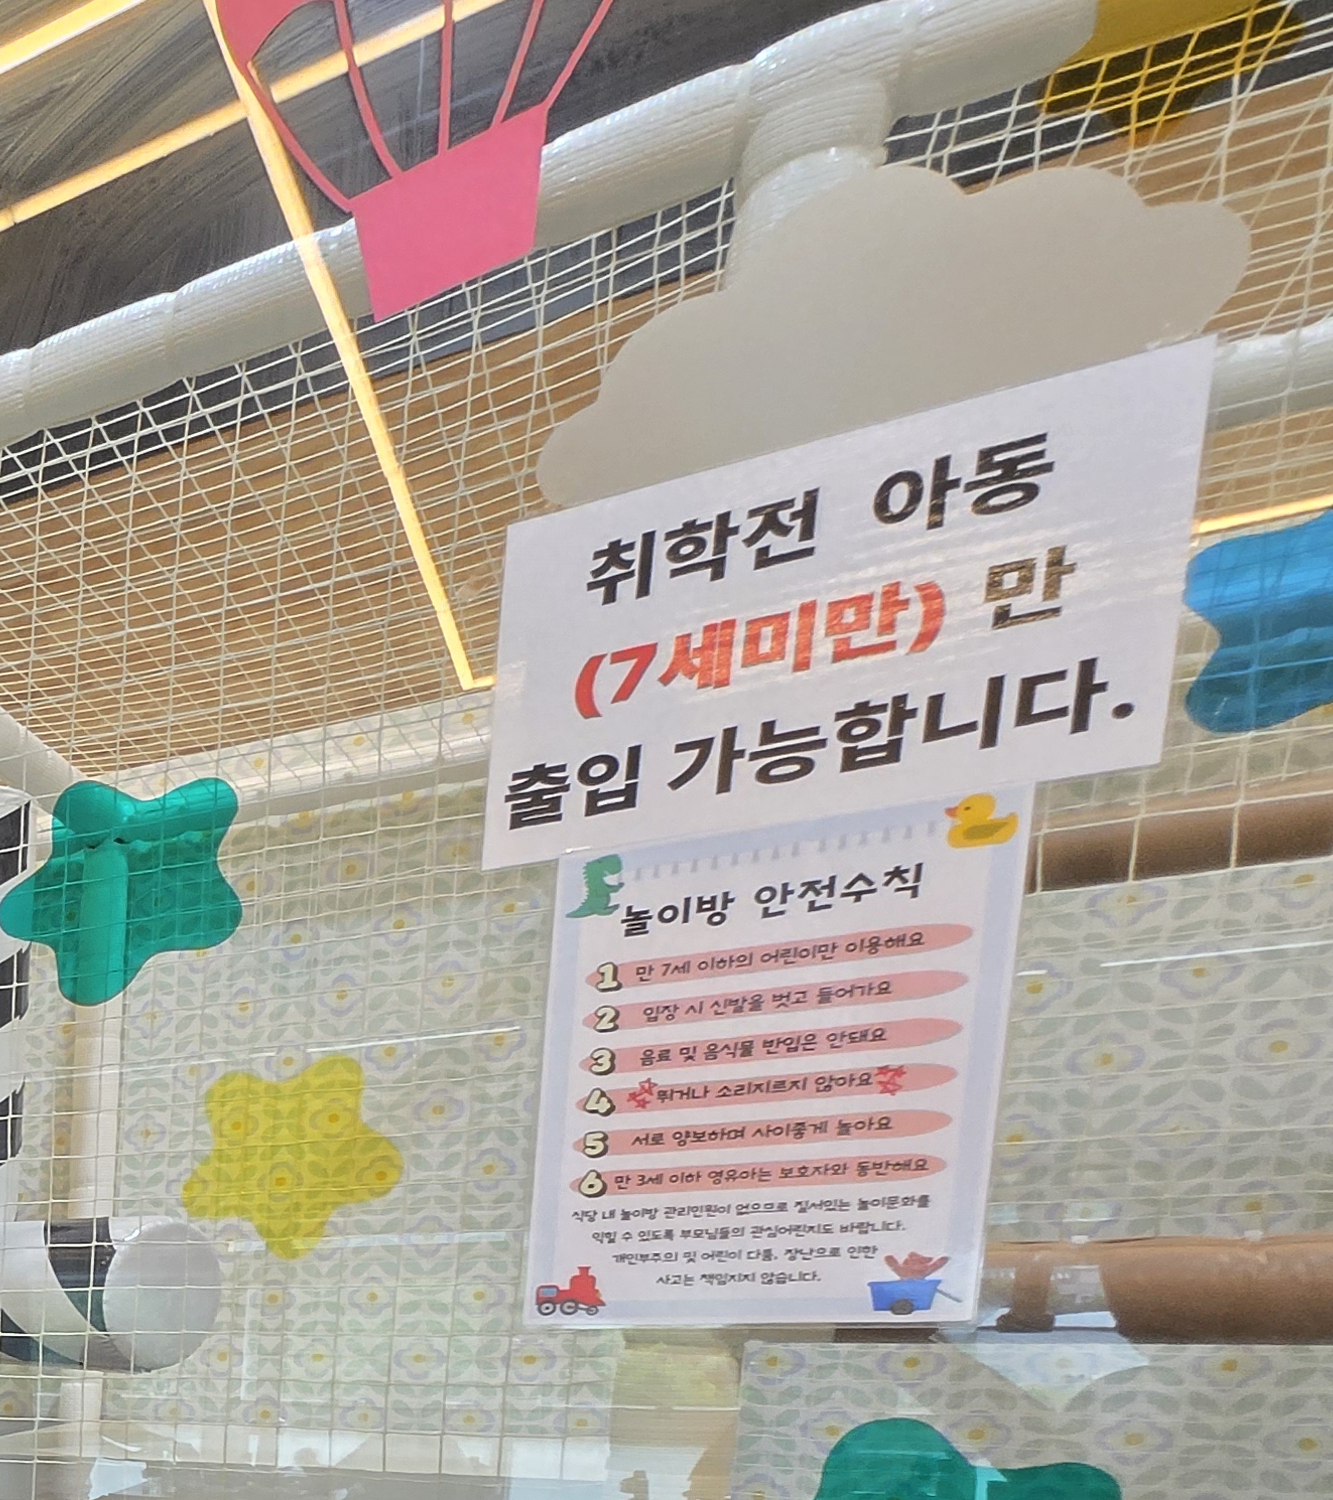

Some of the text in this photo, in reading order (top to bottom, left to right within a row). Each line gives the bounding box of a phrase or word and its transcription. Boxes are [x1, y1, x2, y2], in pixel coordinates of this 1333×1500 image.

[587, 432, 1055, 605] 취학전 아동
[574, 545, 1076, 719] (7세미만) 만
[504, 657, 1134, 830] 출입 가능합니다.
[621, 862, 924, 937] 놀이방 안전수칙
[596, 932, 925, 992] 1 만 7세 이하의 어린이만 이용해요
[594, 980, 892, 1033] 2 입장 시 신발을 벗고 들어가요
[589, 1027, 887, 1076] 3 음료 및 음식물 반입은 안돼요
[585, 1071, 874, 1117] 4 뛰거나 소리지르지 않아요
[583, 1116, 893, 1158] 5 서로 양보하며 사이좋게 놀아요
[578, 1158, 929, 1198] 6 만 3세 이하 영유아는 보호자와 동반해요
[571, 1194, 931, 1222] 식당 내 놀이방 관리인원이 없으므로 질서있는 놀이문화를
[621, 1231, 633, 1242] 수
[637, 1228, 675, 1242] 있도록
[679, 1226, 745, 1241] 부모님들의
[839, 1220, 906, 1234] 바랍니다.
[612, 1251, 679, 1266] 개인부주의
[683, 1251, 697, 1264] 및
[700, 1249, 742, 1263] 어린이
[783, 1246, 842, 1261] 장난으로
[846, 1244, 879, 1260] 인한
[655, 1271, 822, 1286] 사고는 책임지지 않습니다.
